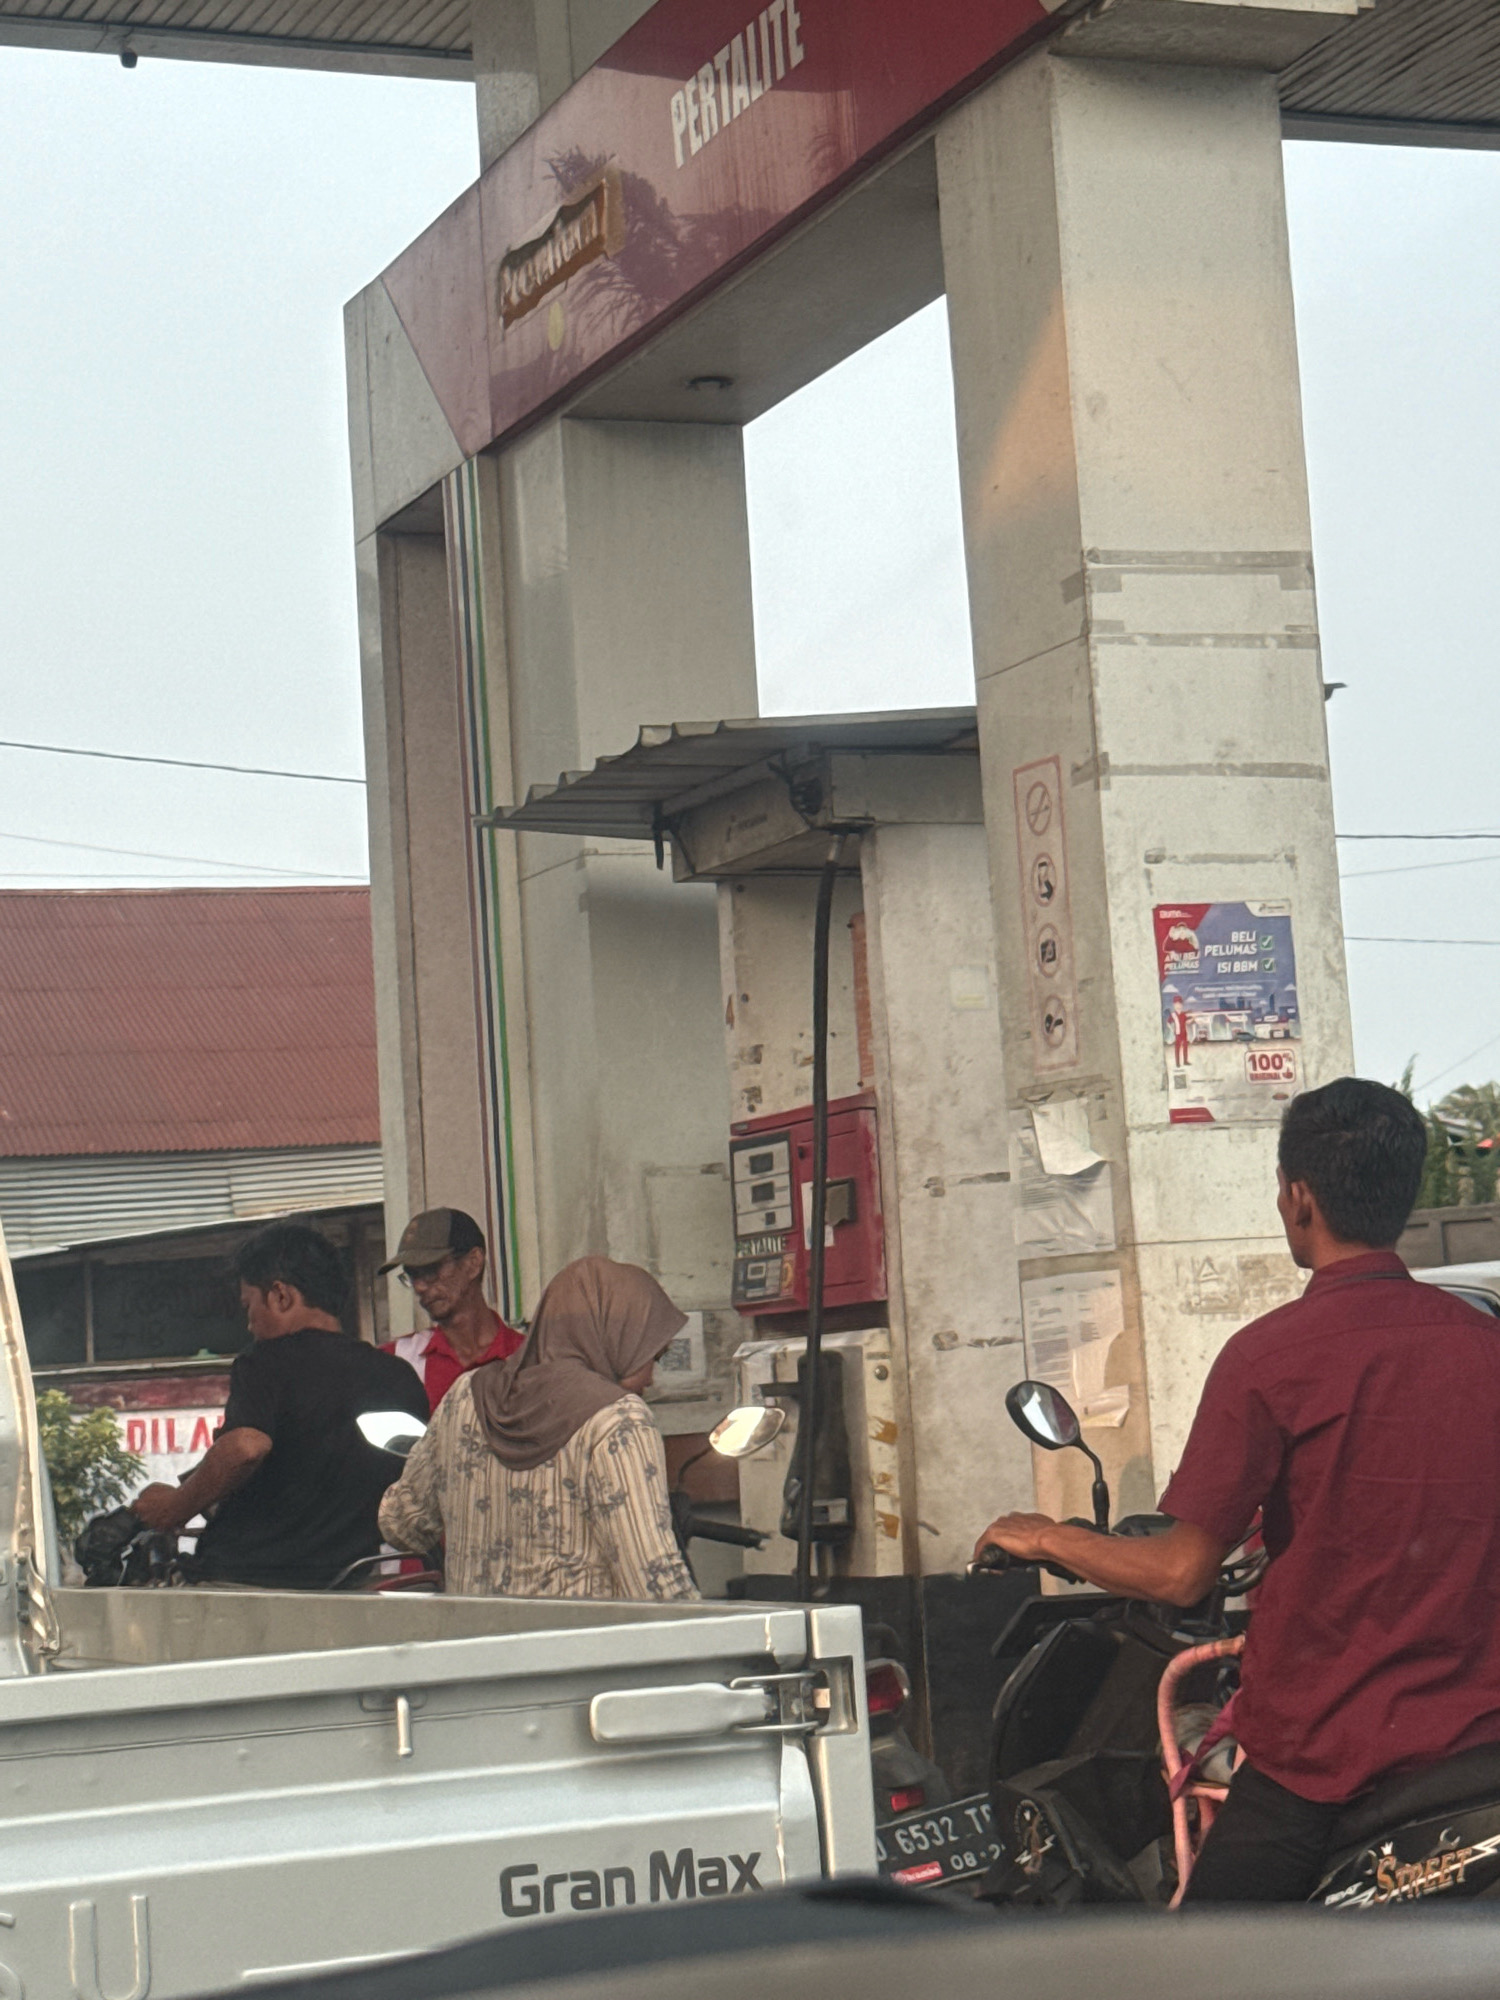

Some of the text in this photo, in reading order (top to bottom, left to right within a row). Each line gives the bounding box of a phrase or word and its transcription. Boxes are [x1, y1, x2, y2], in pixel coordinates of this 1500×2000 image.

[671, 0, 804, 169] PERTALITE
[1204, 944, 1258, 957] PELUMAS
[1231, 931, 1257, 943] BELI
[1217, 960, 1258, 974] ISI BBM
[127, 1416, 225, 1453] DILA
[895, 1816, 959, 1855] 6532
[499, 1847, 764, 1918] Gran Max
